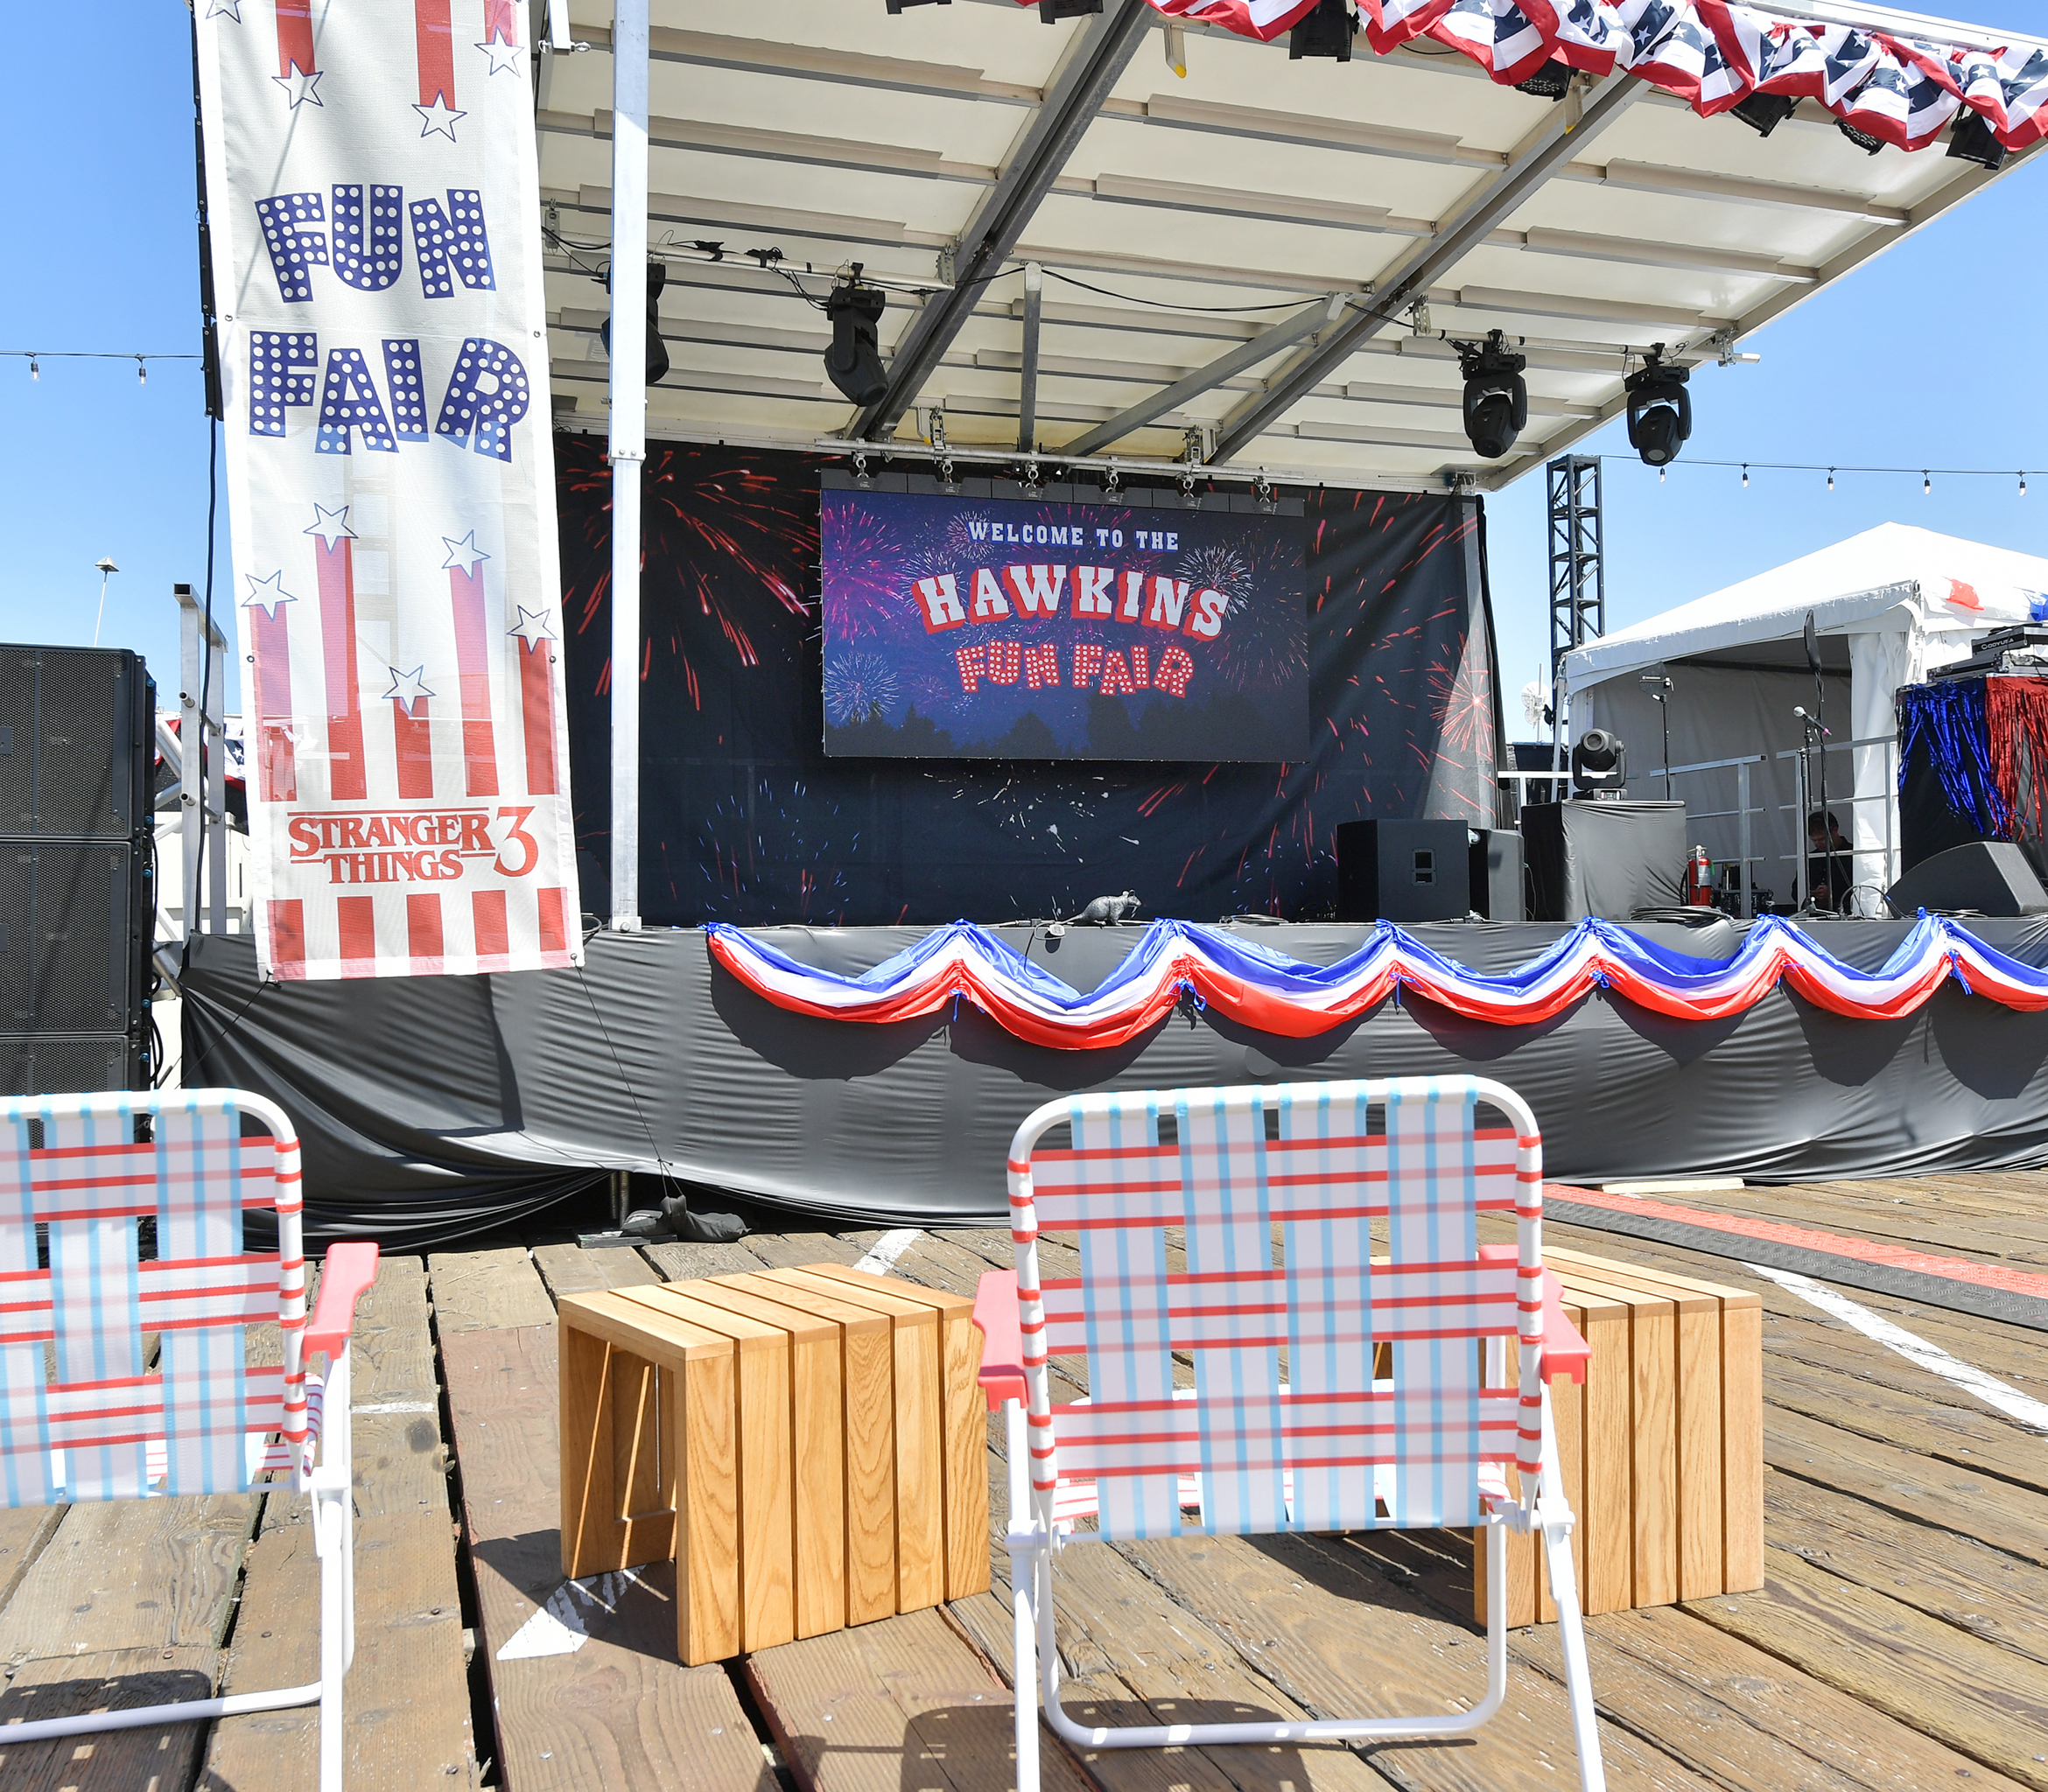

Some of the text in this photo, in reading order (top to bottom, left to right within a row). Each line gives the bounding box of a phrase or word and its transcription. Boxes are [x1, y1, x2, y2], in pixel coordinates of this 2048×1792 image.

[255, 184, 496, 303] FUN
[249, 331, 530, 463] FAIR
[968, 521, 1179, 551] WELCOME TO THE
[911, 564, 1230, 641] HAWKINS
[955, 640, 1196, 697] FUN FAIR
[288, 814, 495, 858] STRANGER
[322, 849, 464, 884] THINGS
[493, 805, 539, 878] 3
